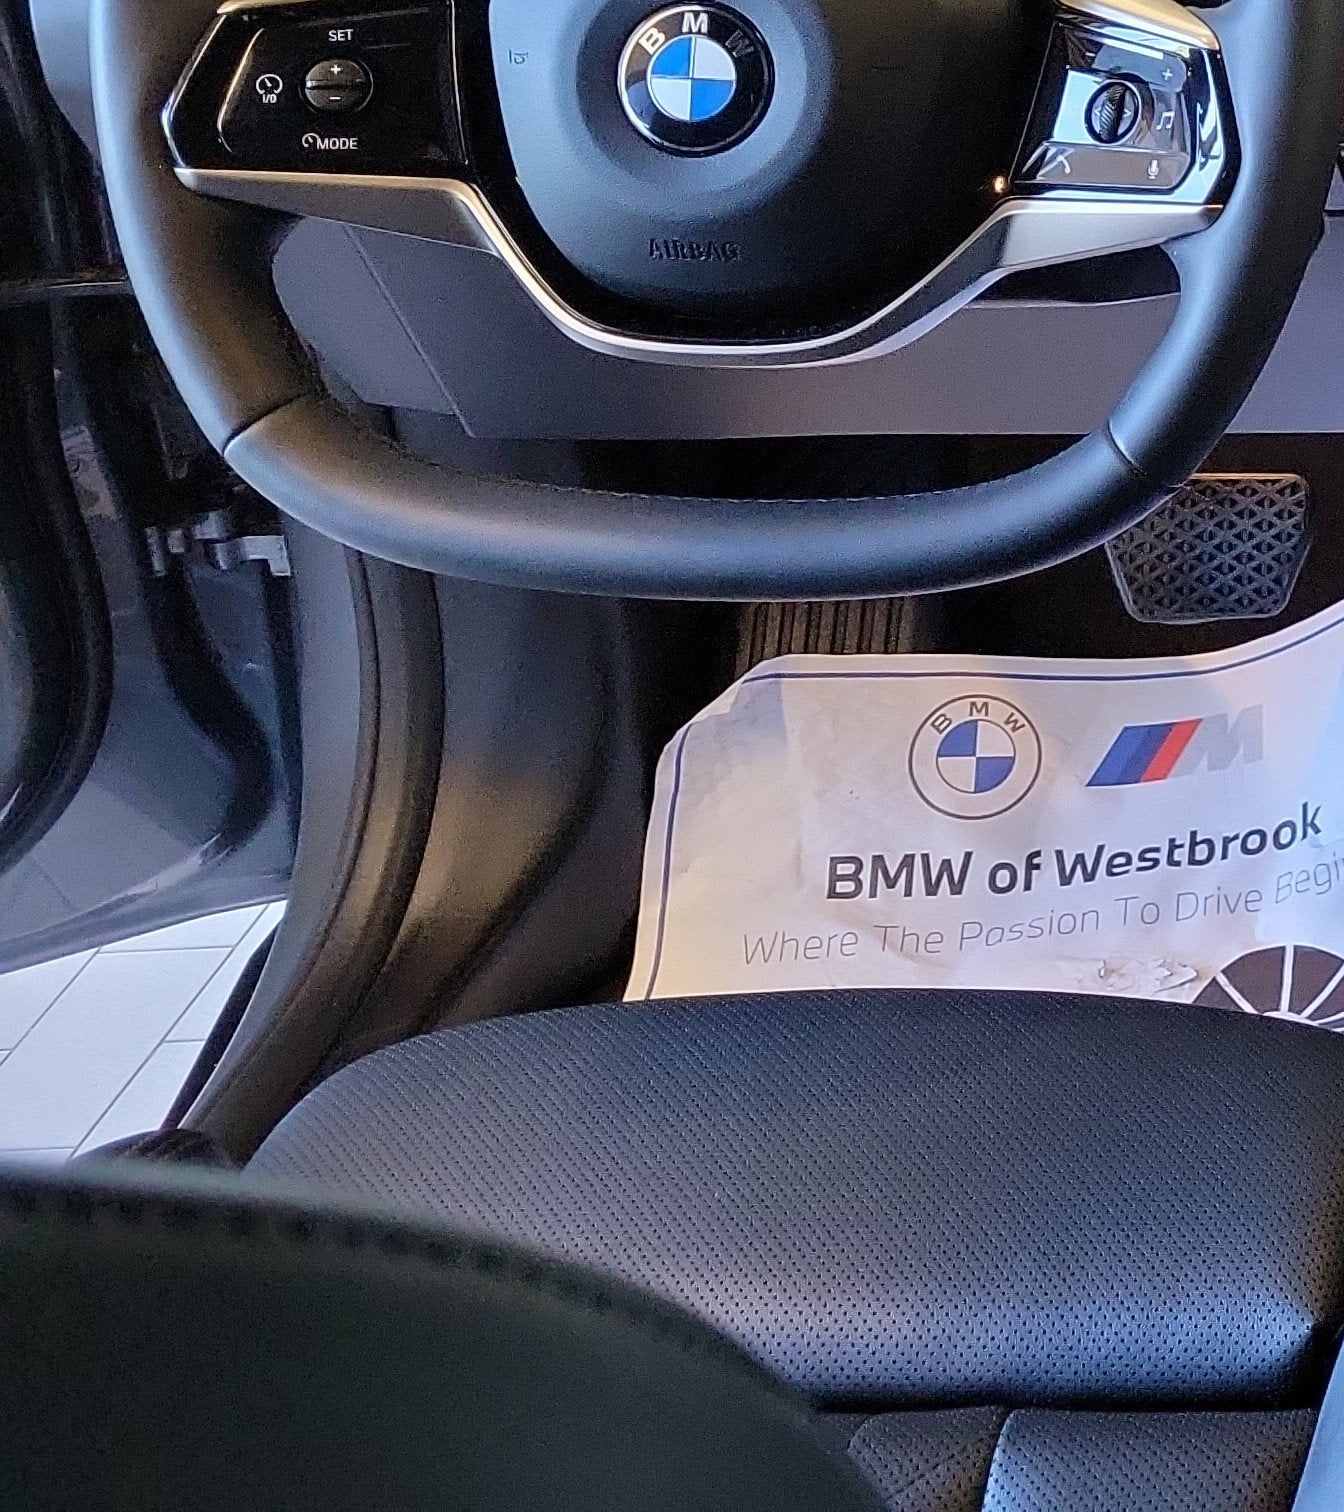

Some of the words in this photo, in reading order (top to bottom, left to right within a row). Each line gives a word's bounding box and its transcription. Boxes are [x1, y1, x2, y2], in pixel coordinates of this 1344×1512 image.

[328, 29, 354, 42] SET
[638, 11, 754, 59] BMW
[316, 138, 359, 151] MODE
[649, 237, 742, 263] AIRBAG
[931, 700, 1026, 735] BMW
[825, 851, 974, 900] BMW
[987, 850, 1042, 894] of
[1053, 801, 1324, 890] Westbrook
[742, 928, 859, 965] Where
[873, 924, 944, 955] The
[958, 906, 1100, 950] Passion
[1113, 896, 1161, 926] To
[1175, 879, 1264, 921] Drive
